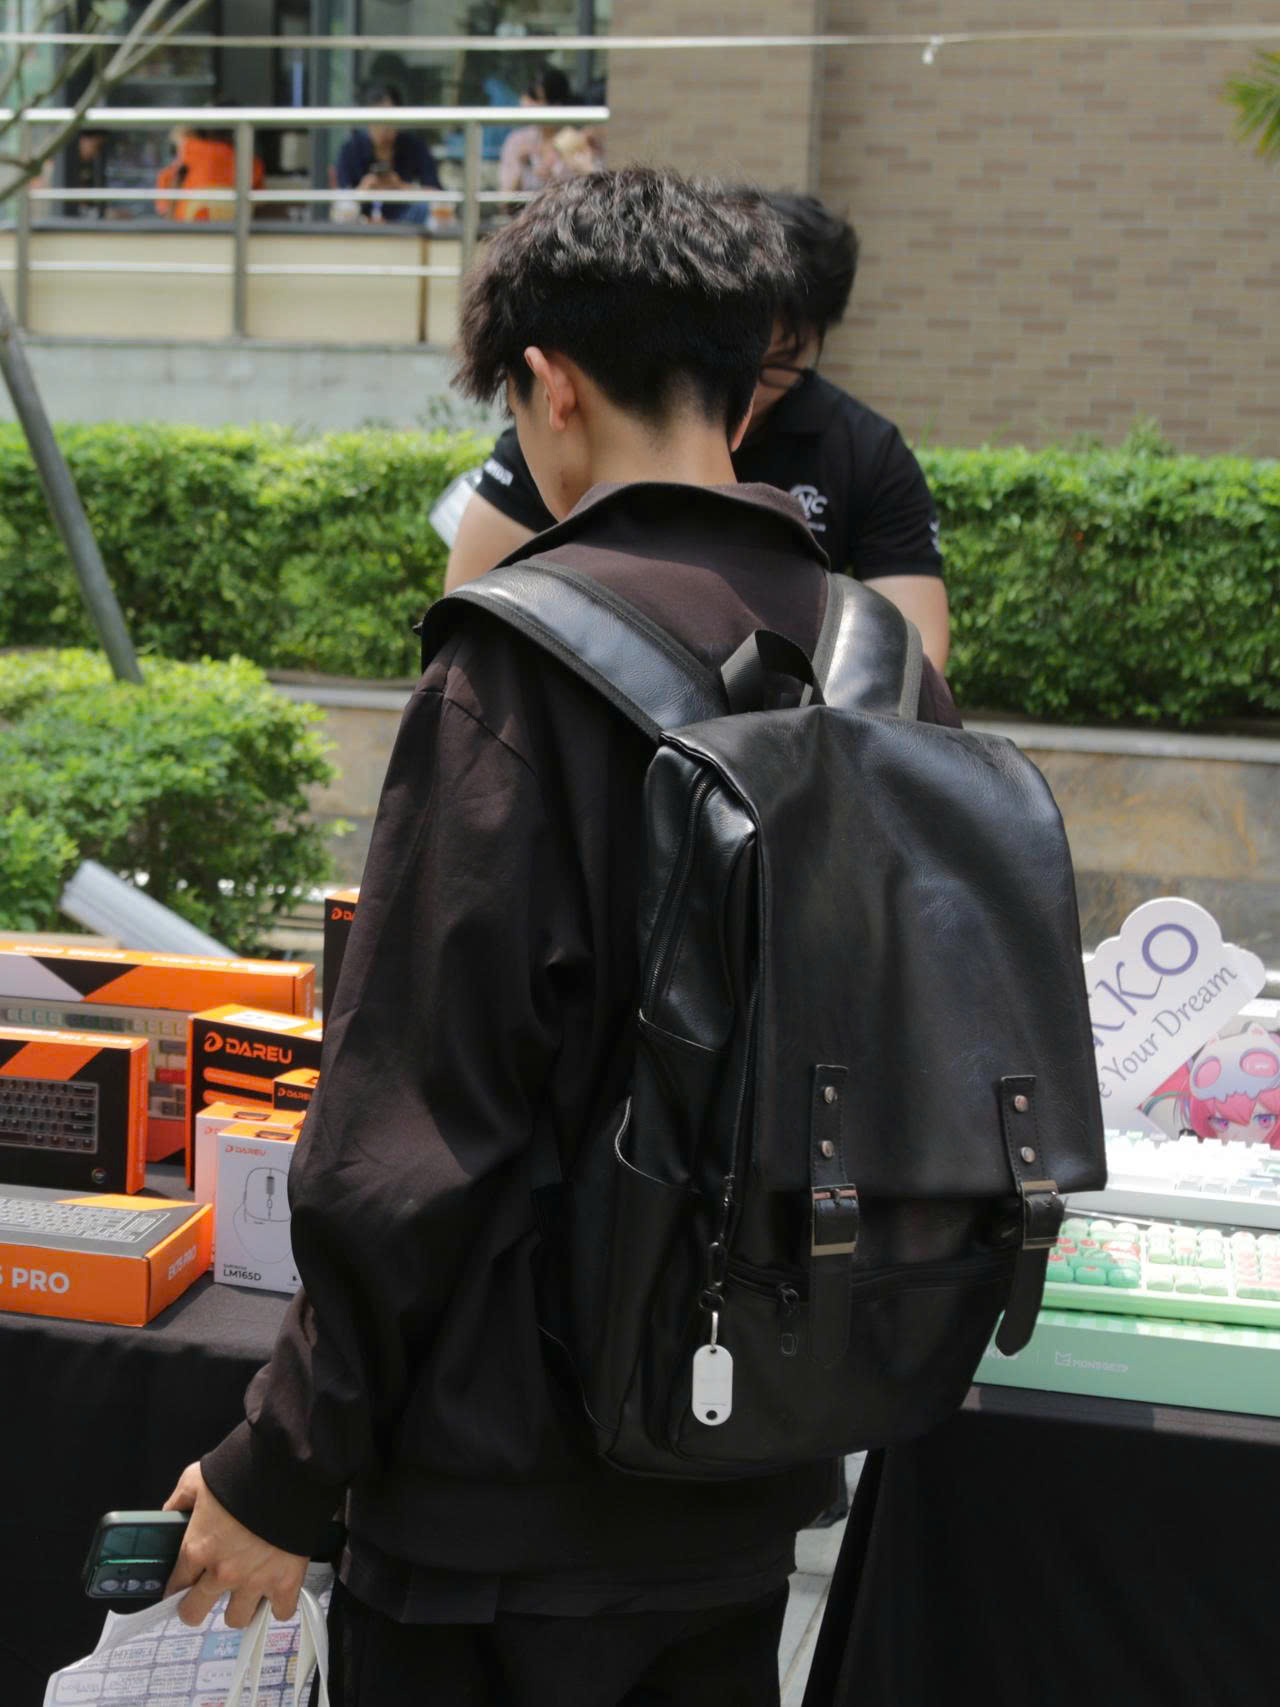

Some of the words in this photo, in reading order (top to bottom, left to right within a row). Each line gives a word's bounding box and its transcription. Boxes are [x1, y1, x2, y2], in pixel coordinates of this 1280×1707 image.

[1101, 1033, 1160, 1081] Your
[1152, 966, 1237, 1037] Dream
[225, 1037, 293, 1064] DAREU
[287, 1090, 312, 1101] DARE
[11, 1267, 70, 1294] PRO
[223, 1268, 262, 1281] LM165D
